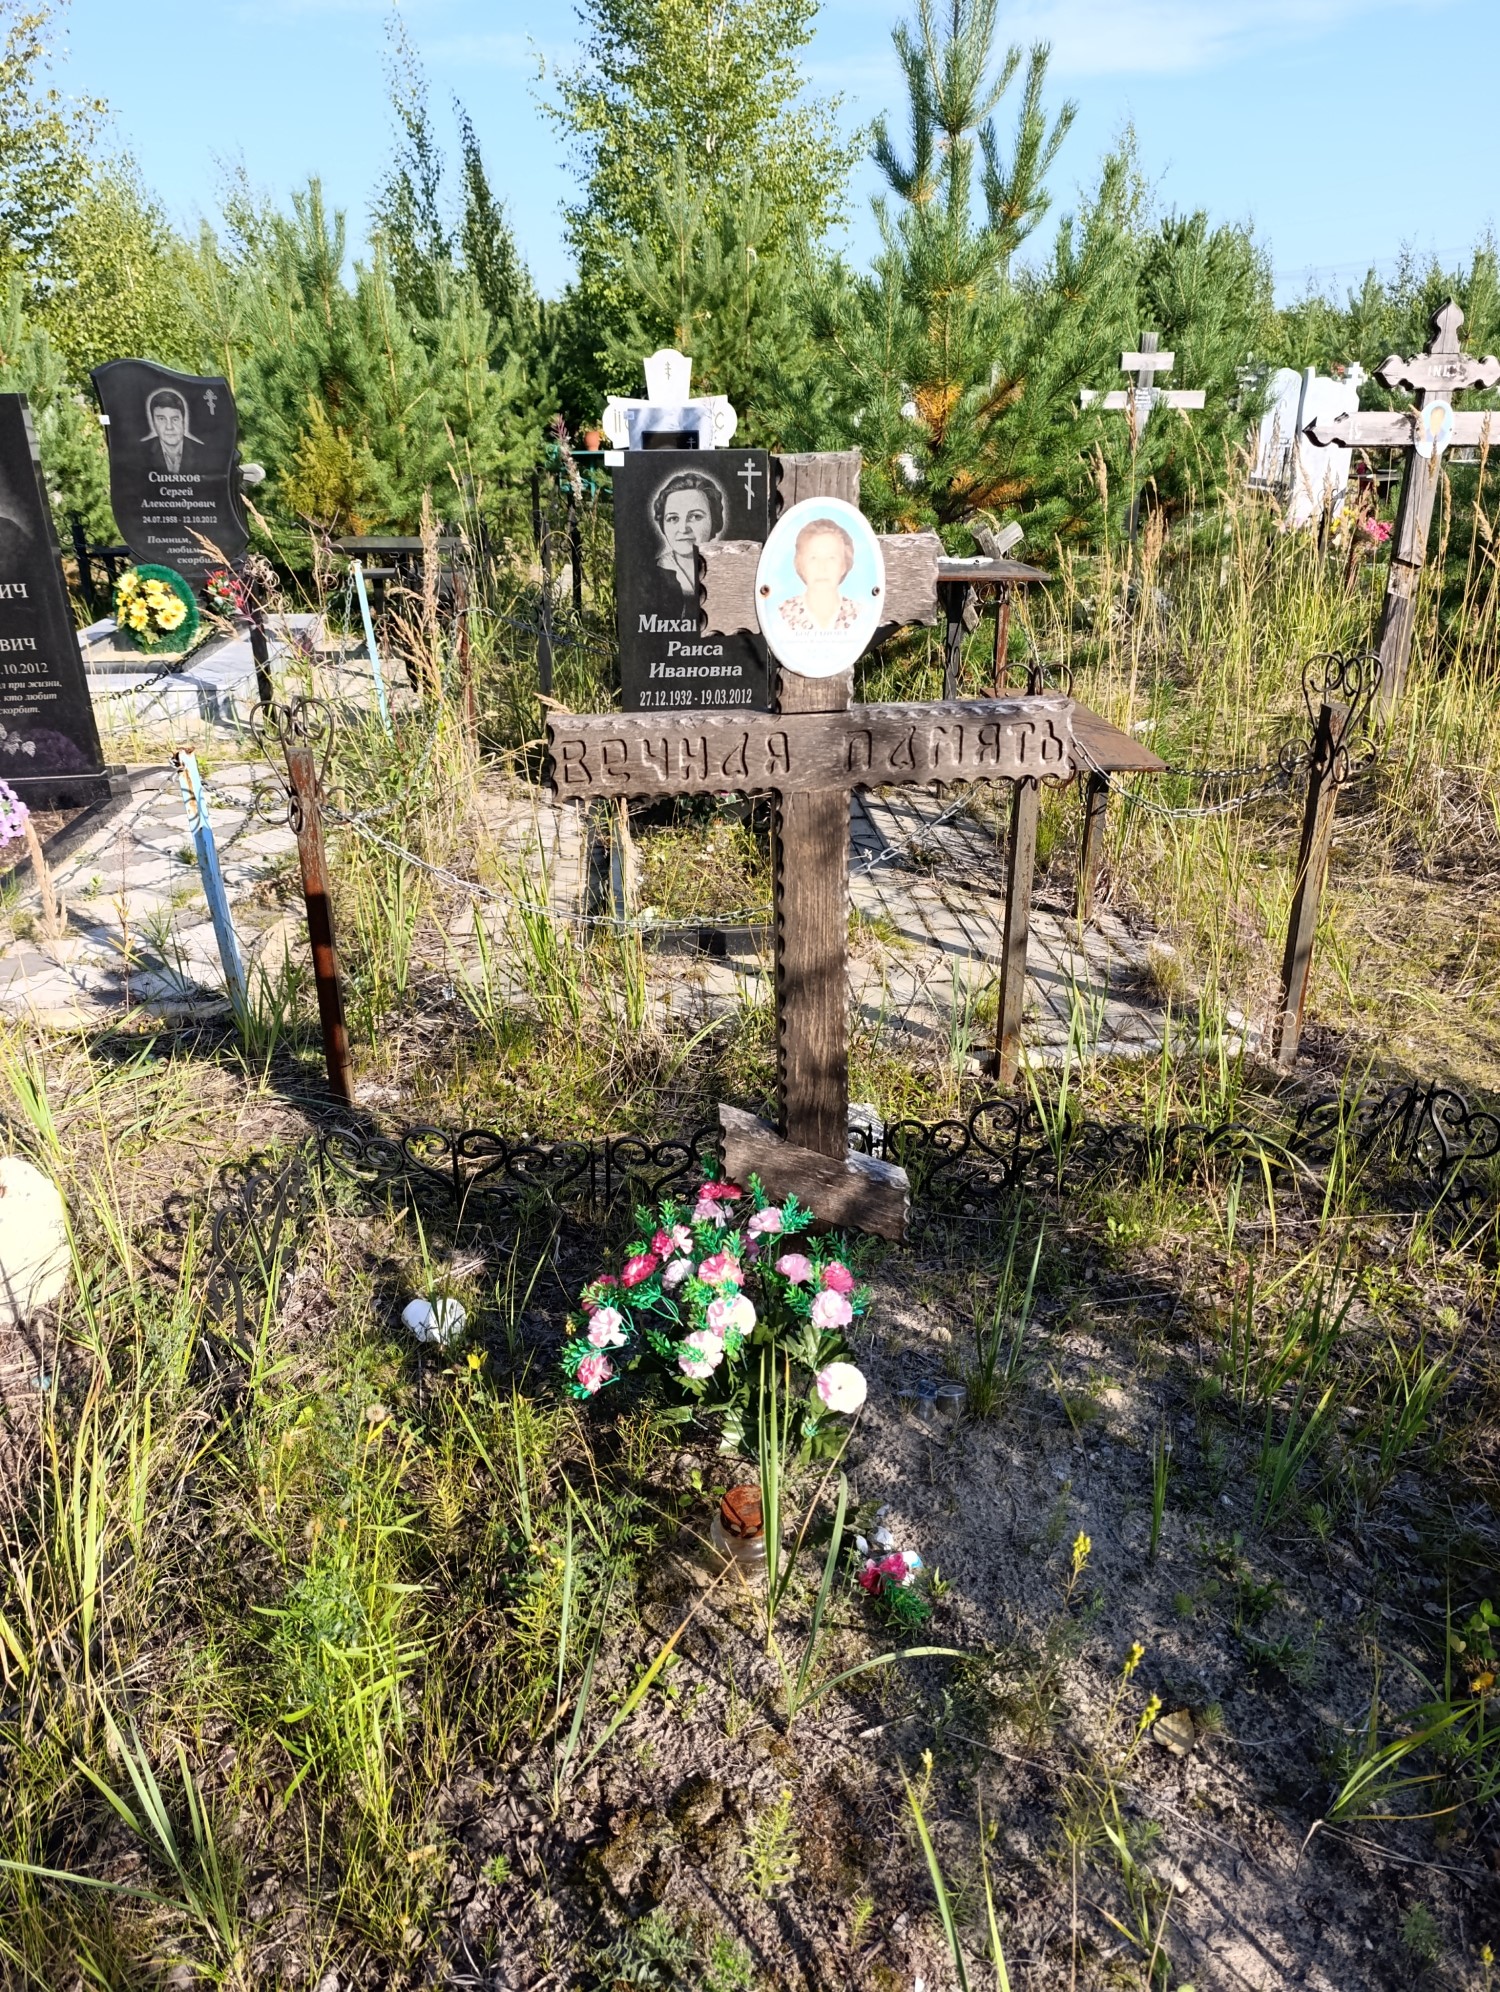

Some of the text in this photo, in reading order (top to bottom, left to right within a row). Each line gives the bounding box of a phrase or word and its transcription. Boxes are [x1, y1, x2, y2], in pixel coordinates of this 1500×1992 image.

[148, 471, 201, 483] Синяков
[159, 487, 194, 498] Сергей
[141, 499, 216, 510] Александрович
[667, 640, 724, 657] Раиса
[649, 662, 743, 678] Ивановна
[8, 682, 26, 691] при
[25, 691, 58, 700] любит
[640, 690, 692, 706] 27.12.1932
[701, 688, 752, 705] 19.03.2012
